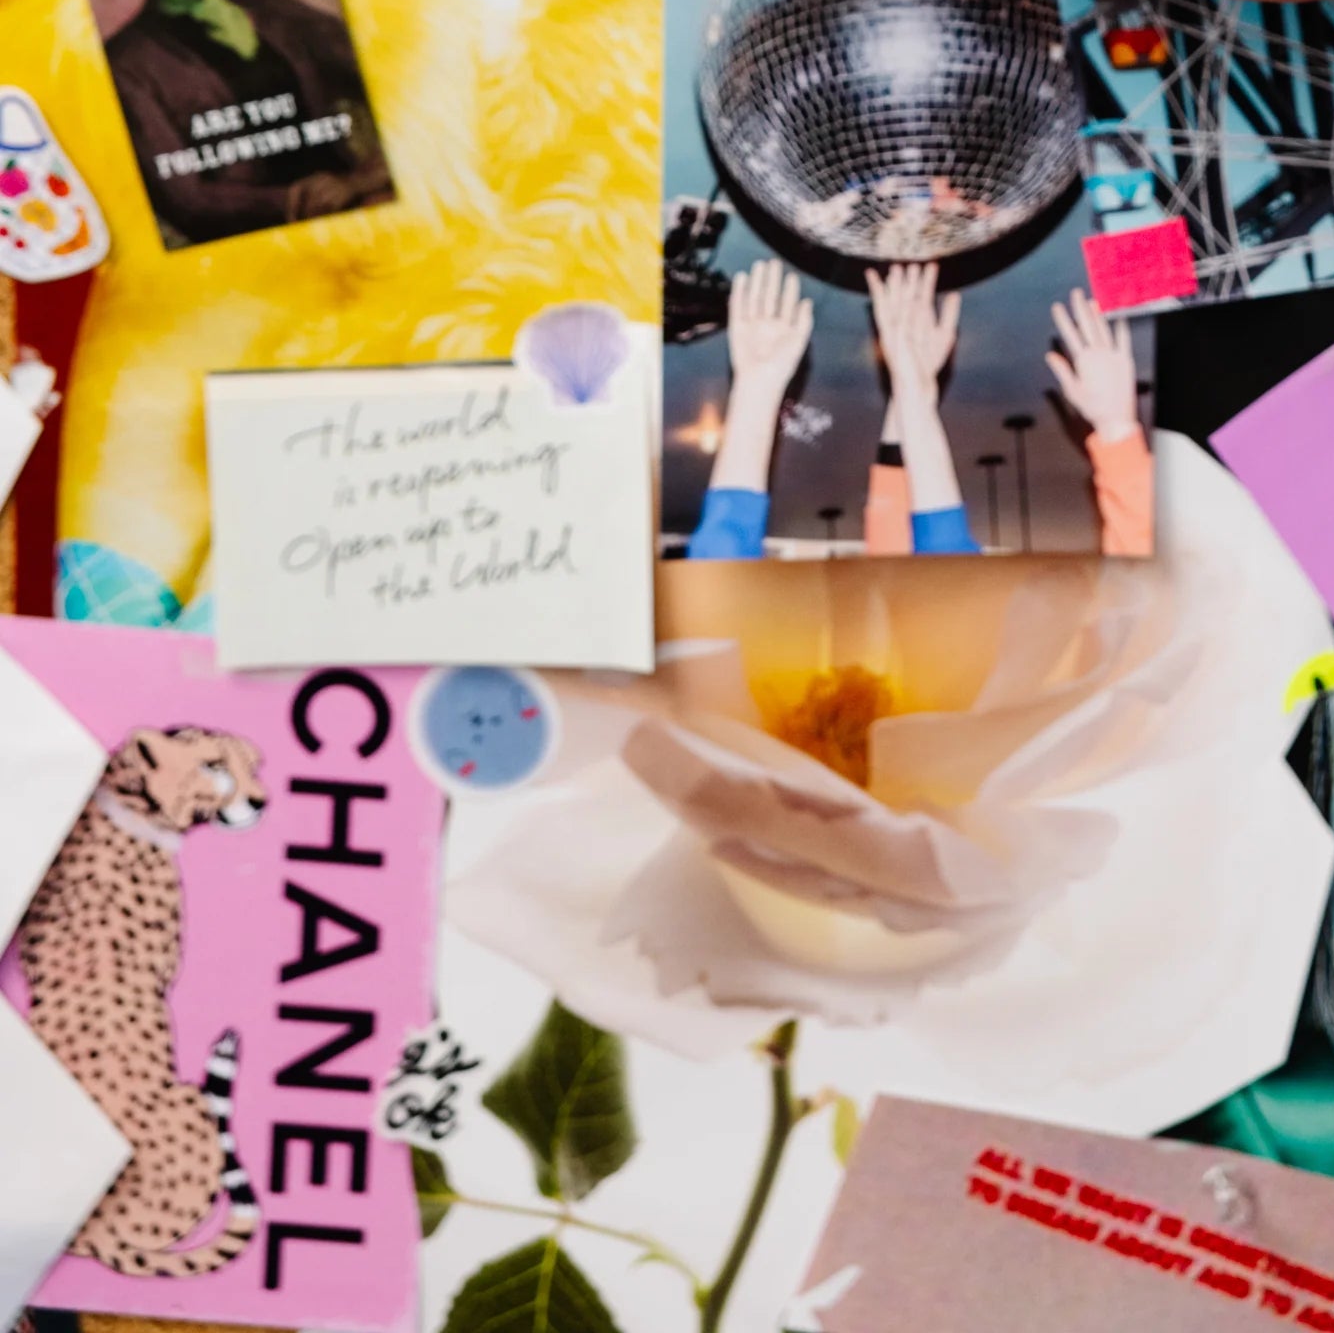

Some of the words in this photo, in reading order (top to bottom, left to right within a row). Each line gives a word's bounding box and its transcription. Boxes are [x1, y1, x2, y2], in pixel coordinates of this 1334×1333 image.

[191, 104, 245, 139] ARE
[243, 92, 297, 126] YOU
[154, 125, 301, 180] FOLLOWING
[301, 113, 352, 146] ME?
[460, 496, 500, 533] to
[262, 669, 391, 1290] CHANEL
